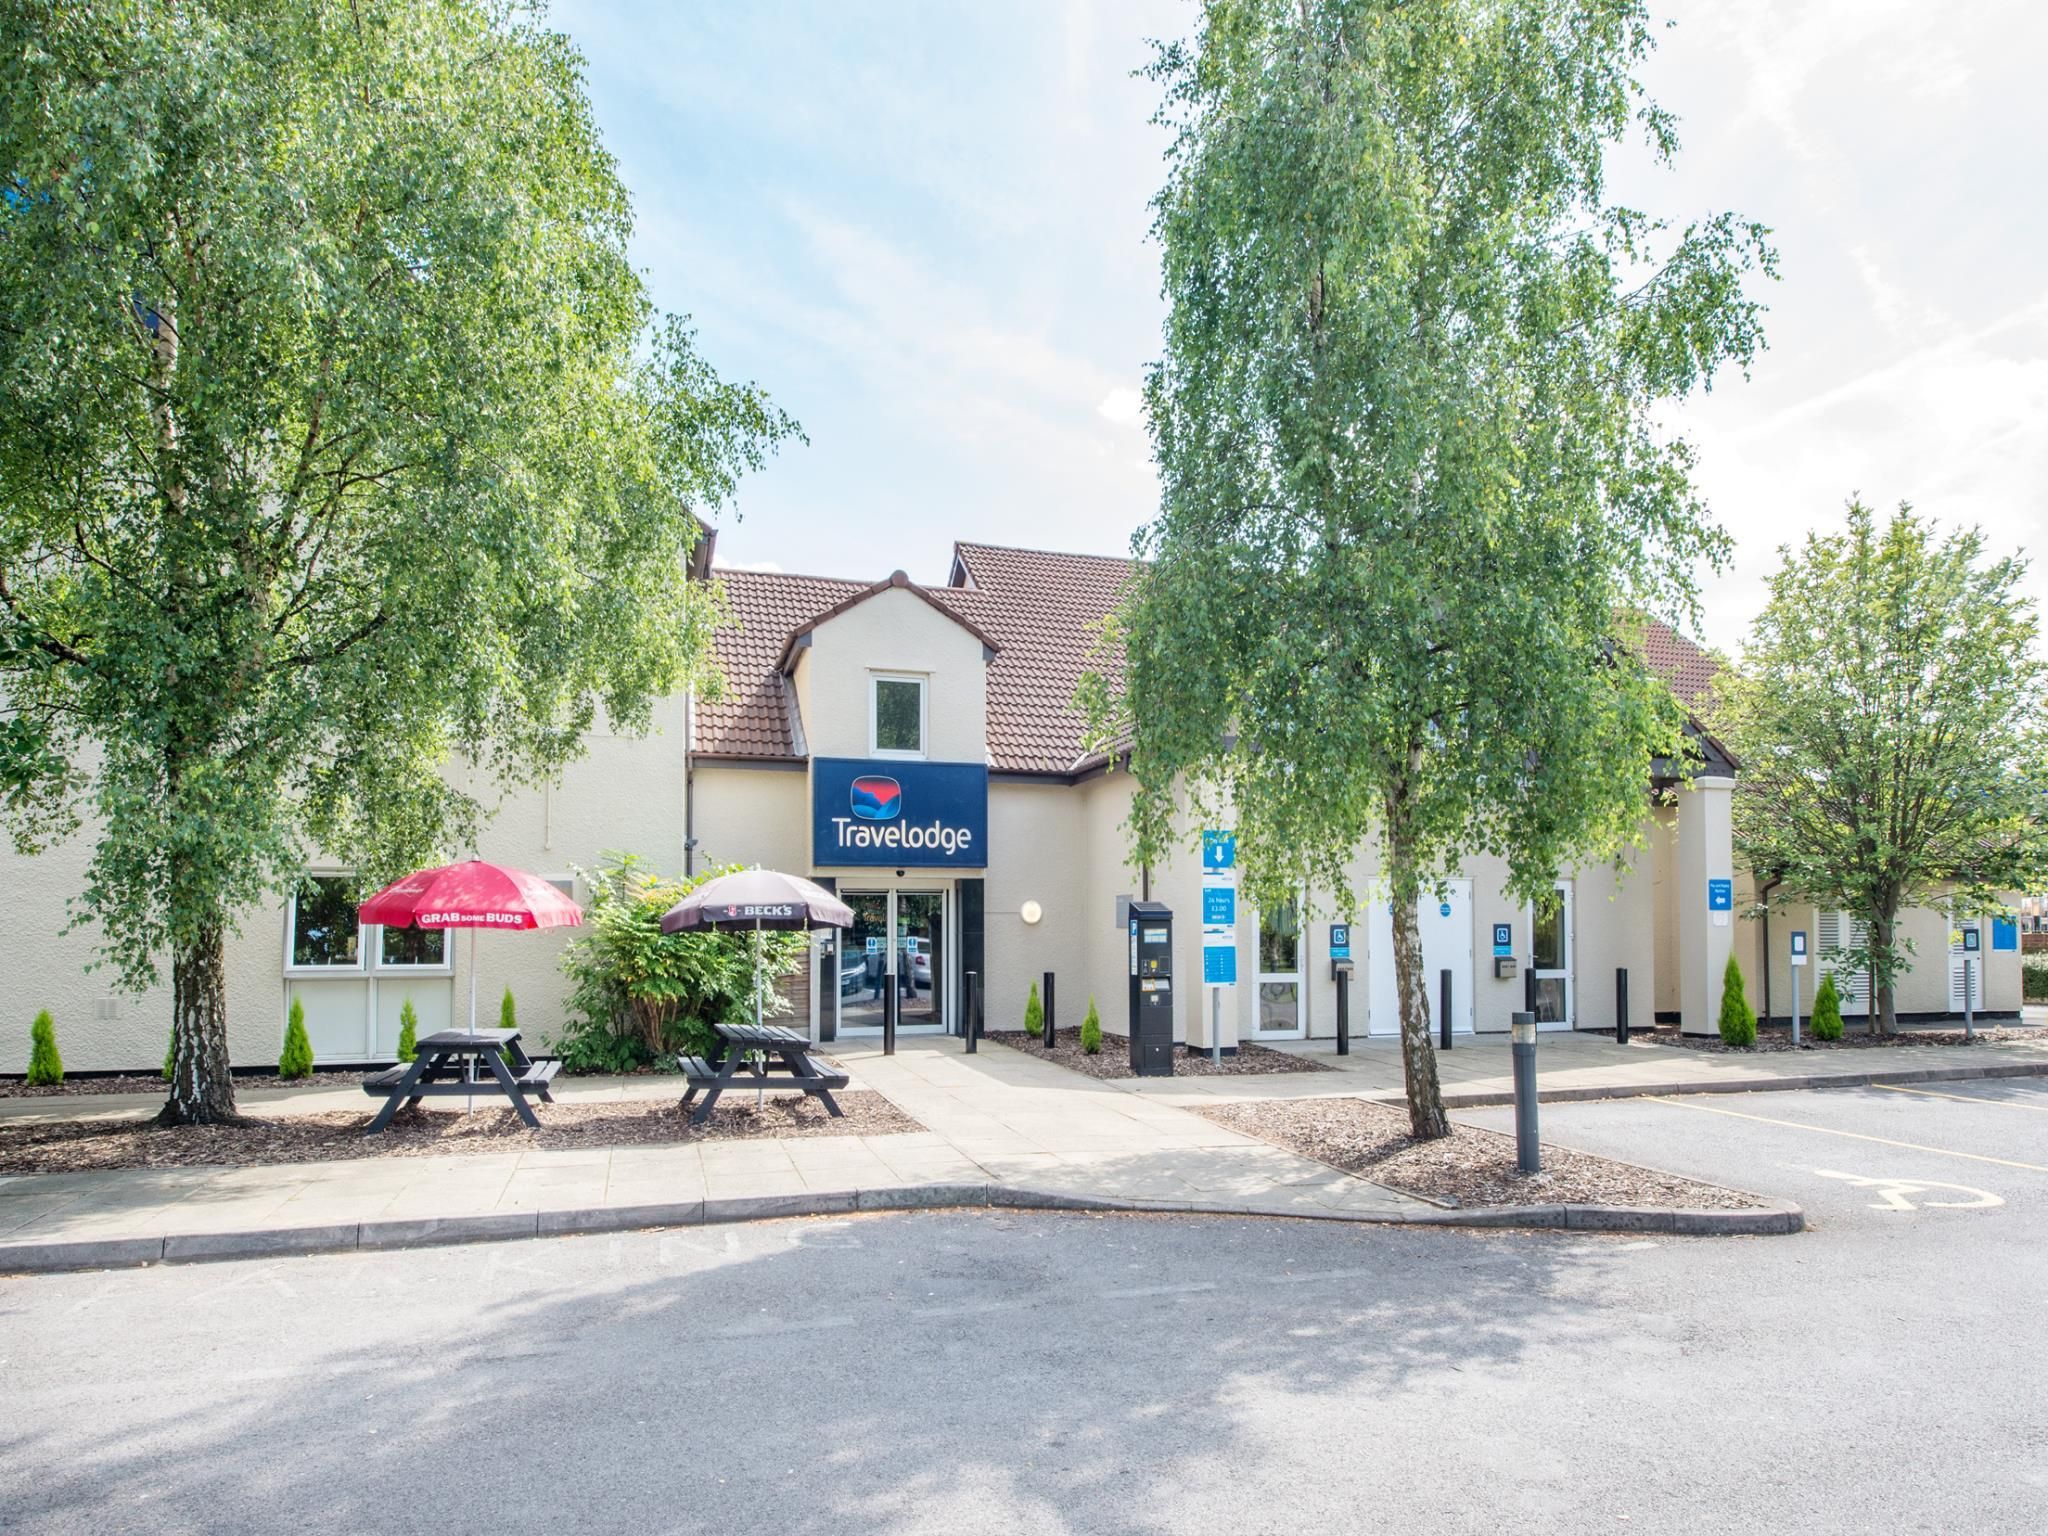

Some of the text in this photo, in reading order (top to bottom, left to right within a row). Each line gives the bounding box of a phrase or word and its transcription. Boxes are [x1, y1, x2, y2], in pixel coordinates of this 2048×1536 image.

[831, 818, 972, 855] Travelodge
[744, 905, 793, 916] BECK'S
[421, 911, 523, 924] GRAB SOME BUDS
